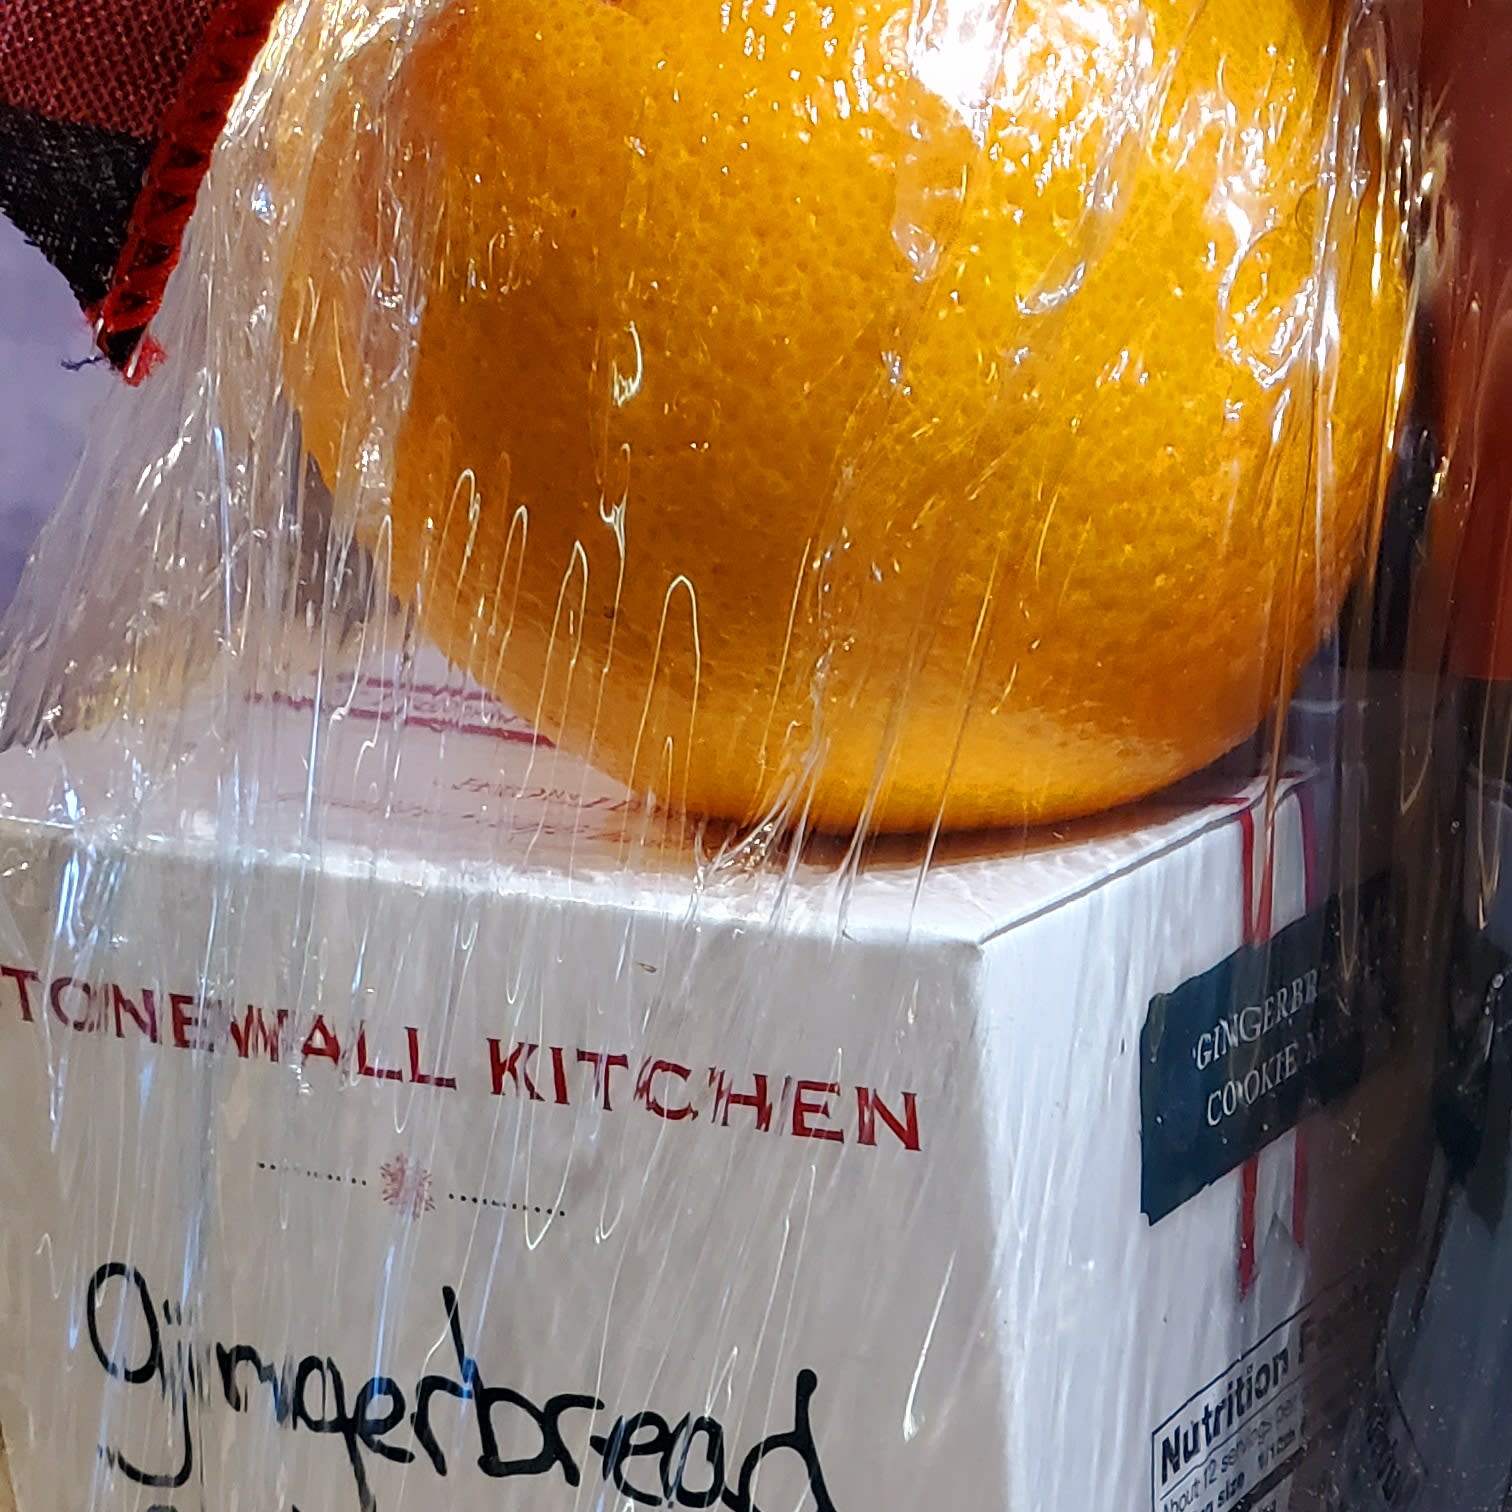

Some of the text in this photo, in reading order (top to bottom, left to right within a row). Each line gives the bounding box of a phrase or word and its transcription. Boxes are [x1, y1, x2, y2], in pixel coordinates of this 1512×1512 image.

[0, 964, 922, 1152] TONEWALL KITCHEN
[1195, 968, 1319, 1070] GINGERBR
[1207, 1043, 1299, 1127] COOKIE
[1160, 1347, 1290, 1486] Nutrition
[1203, 1458, 1218, 1492] 12
[1217, 1472, 1245, 1509] size
